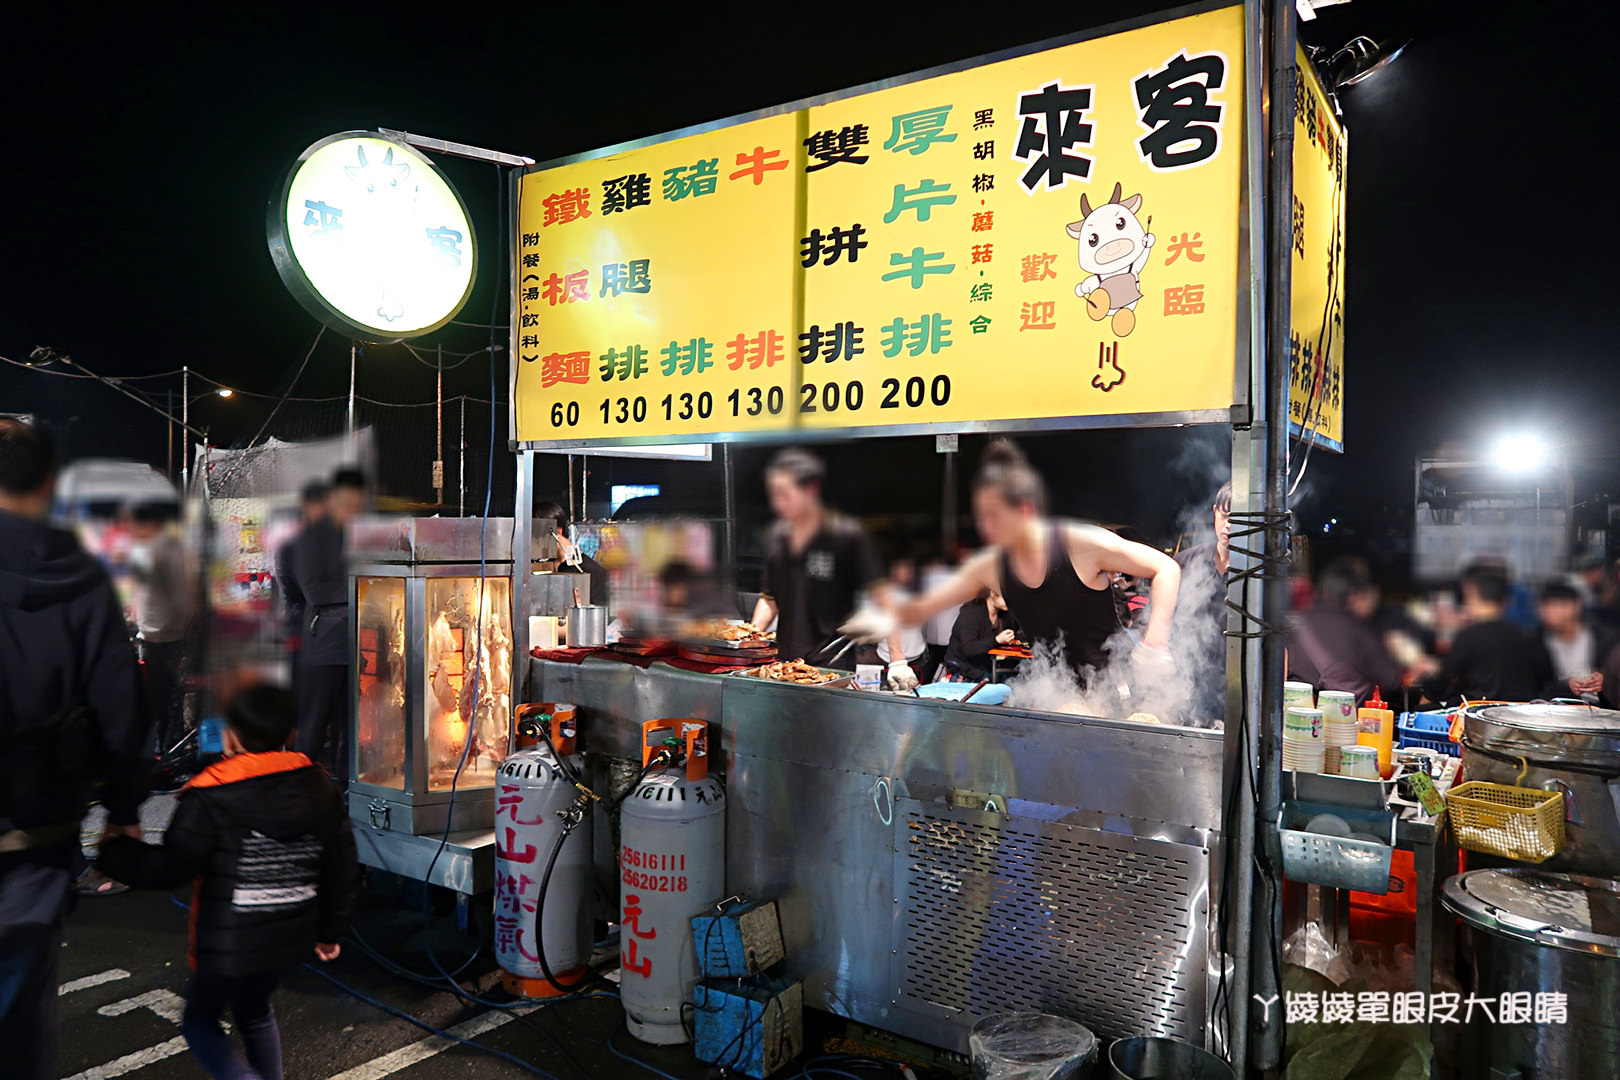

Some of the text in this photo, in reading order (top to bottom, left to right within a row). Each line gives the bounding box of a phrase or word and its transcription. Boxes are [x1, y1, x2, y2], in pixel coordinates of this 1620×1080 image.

[1013, 51, 1228, 193] 來客
[541, 187, 593, 389] 鐵板麵
[599, 172, 652, 382] 雞腿排
[660, 157, 720, 378] 豬排
[725, 146, 790, 372] 牛排
[797, 123, 870, 364] 雙拼排
[879, 103, 959, 358] 厚片牛排
[1019, 252, 1058, 333] 歡迎
[1163, 232, 1206, 318] 光臨
[550, 374, 952, 428] 60 130 130 130 200 200
[621, 894, 656, 979] 元山
